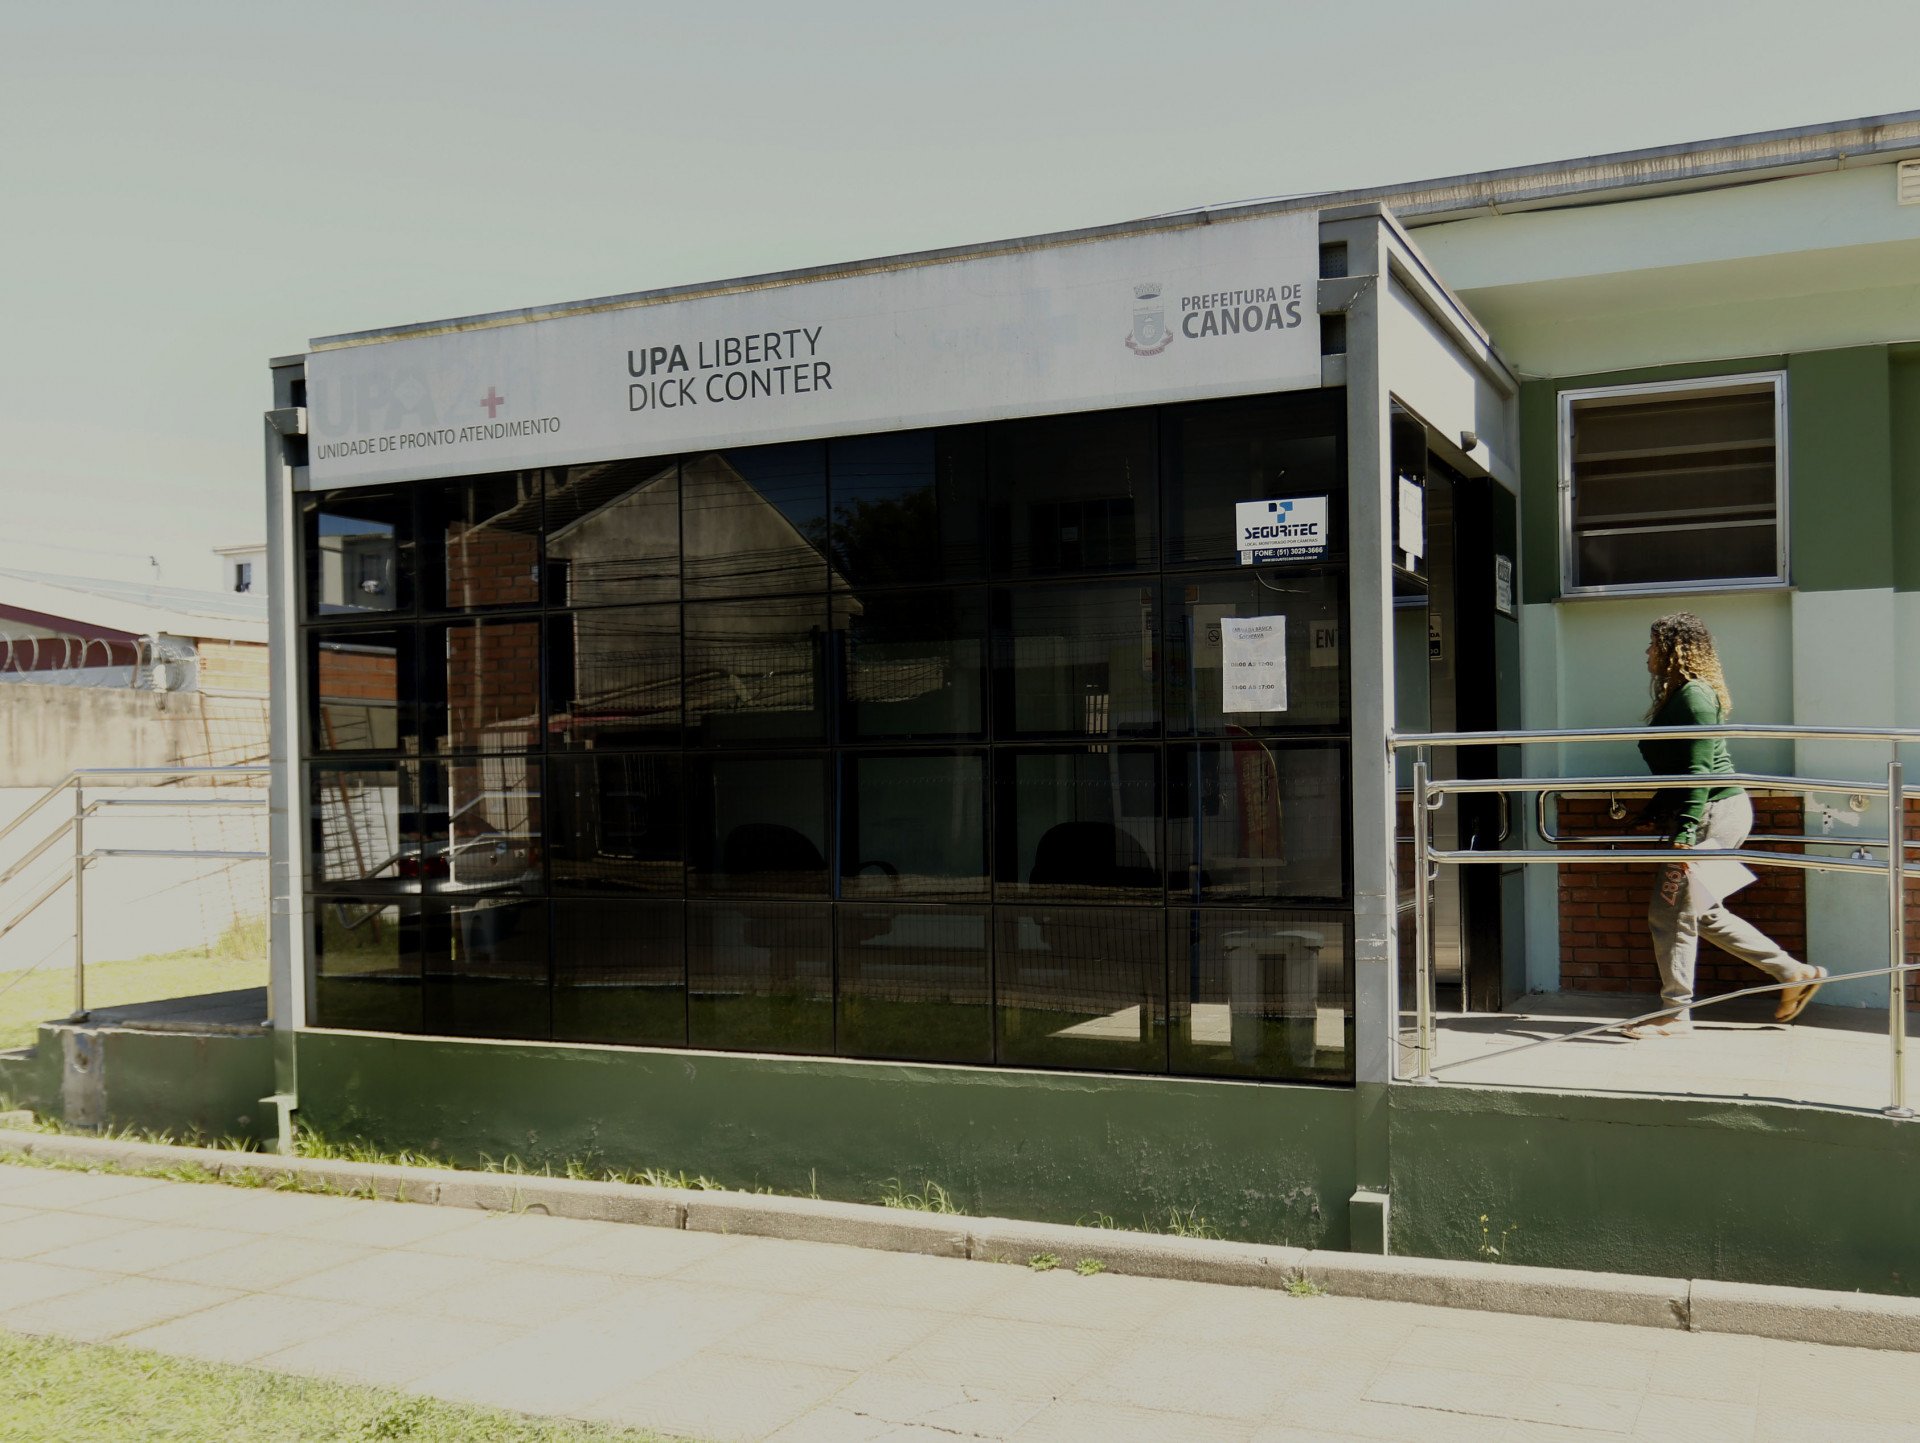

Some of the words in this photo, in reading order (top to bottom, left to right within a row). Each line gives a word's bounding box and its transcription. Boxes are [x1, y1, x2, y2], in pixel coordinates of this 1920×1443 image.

[1181, 287, 1277, 312] PREFEITURA
[1281, 283, 1302, 301] DE
[1181, 300, 1303, 339] CANOAS
[627, 344, 690, 378] UPA
[698, 325, 823, 370] LIBERTY
[628, 376, 698, 412] DICK
[705, 361, 833, 403] CONTER
[317, 438, 376, 460] UNIDADE
[378, 435, 397, 453] DE
[399, 428, 456, 450] PRONTO
[458, 416, 561, 443] ATENDIMENTO
[1254, 549, 1276, 557] FONE:
[1276, 548, 1290, 557] (51)
